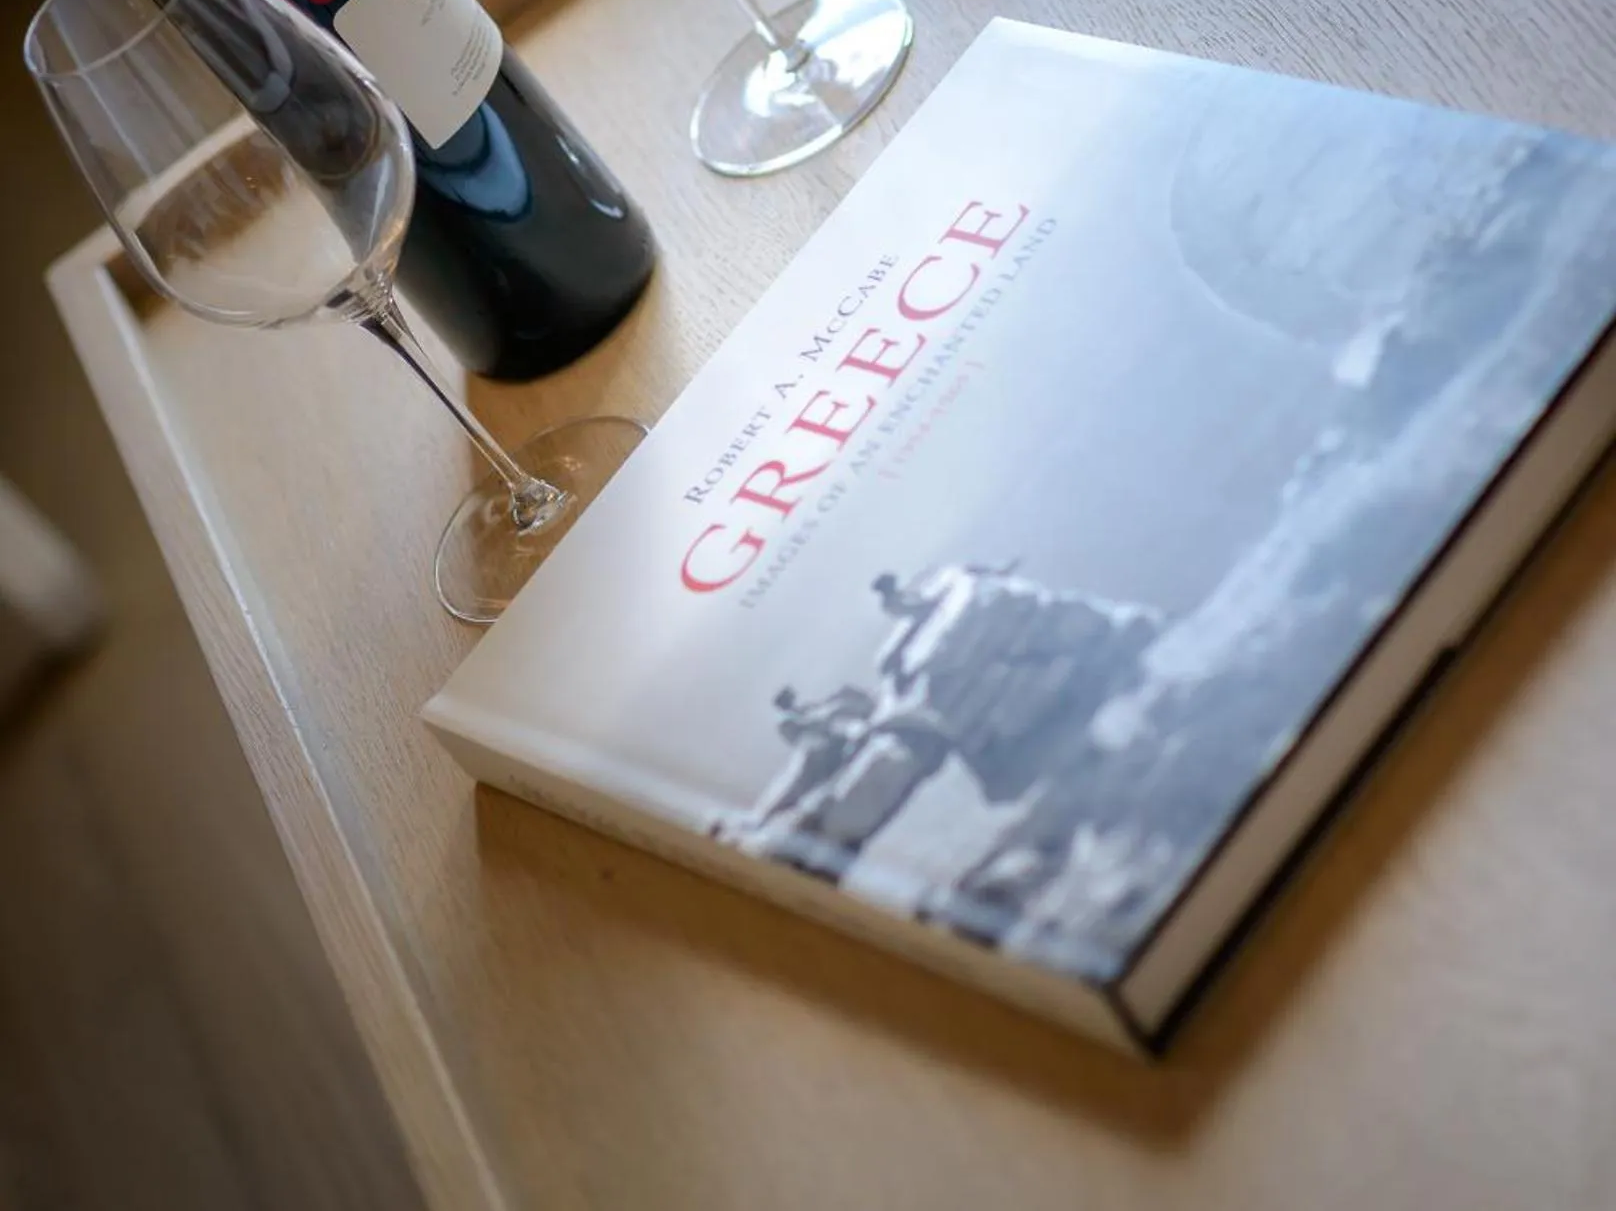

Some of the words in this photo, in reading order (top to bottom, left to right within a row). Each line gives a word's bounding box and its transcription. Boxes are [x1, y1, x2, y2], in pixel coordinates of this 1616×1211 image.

[681, 201, 1030, 593] GREECE
[684, 407, 771, 504] ROBERT
[774, 372, 804, 399] A.
[740, 510, 819, 609] IMAGES
[817, 480, 847, 514] OF
[850, 439, 881, 479] AN
[878, 287, 1004, 437] ENCHANTED
[1006, 217, 1057, 283] LAND
